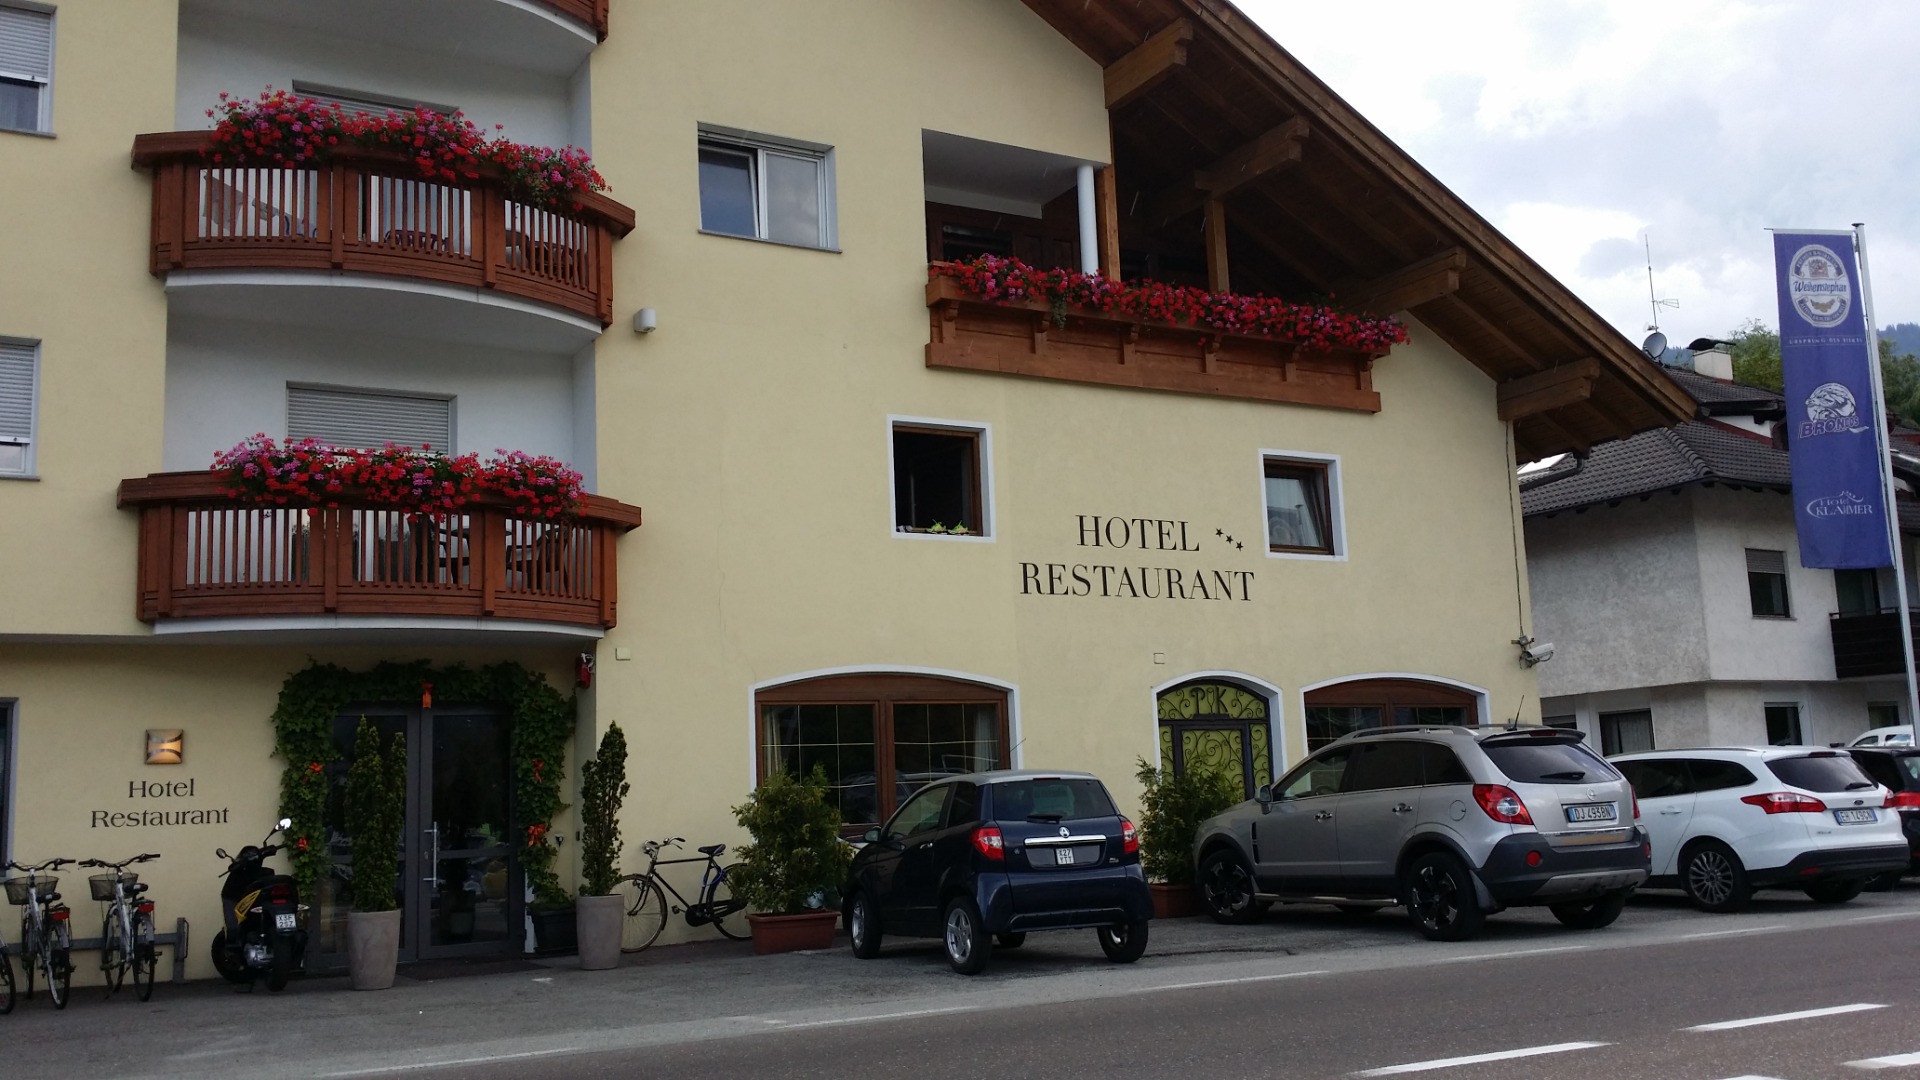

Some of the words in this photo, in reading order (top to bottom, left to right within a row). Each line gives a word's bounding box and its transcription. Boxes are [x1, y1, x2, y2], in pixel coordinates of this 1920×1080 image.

[1799, 416, 1860, 439] BRONCOS
[1075, 514, 1200, 552] HOTEL
[1019, 562, 1255, 602] RESTAURANT
[128, 778, 194, 798] Hotel
[91, 807, 229, 828] Restaurant
